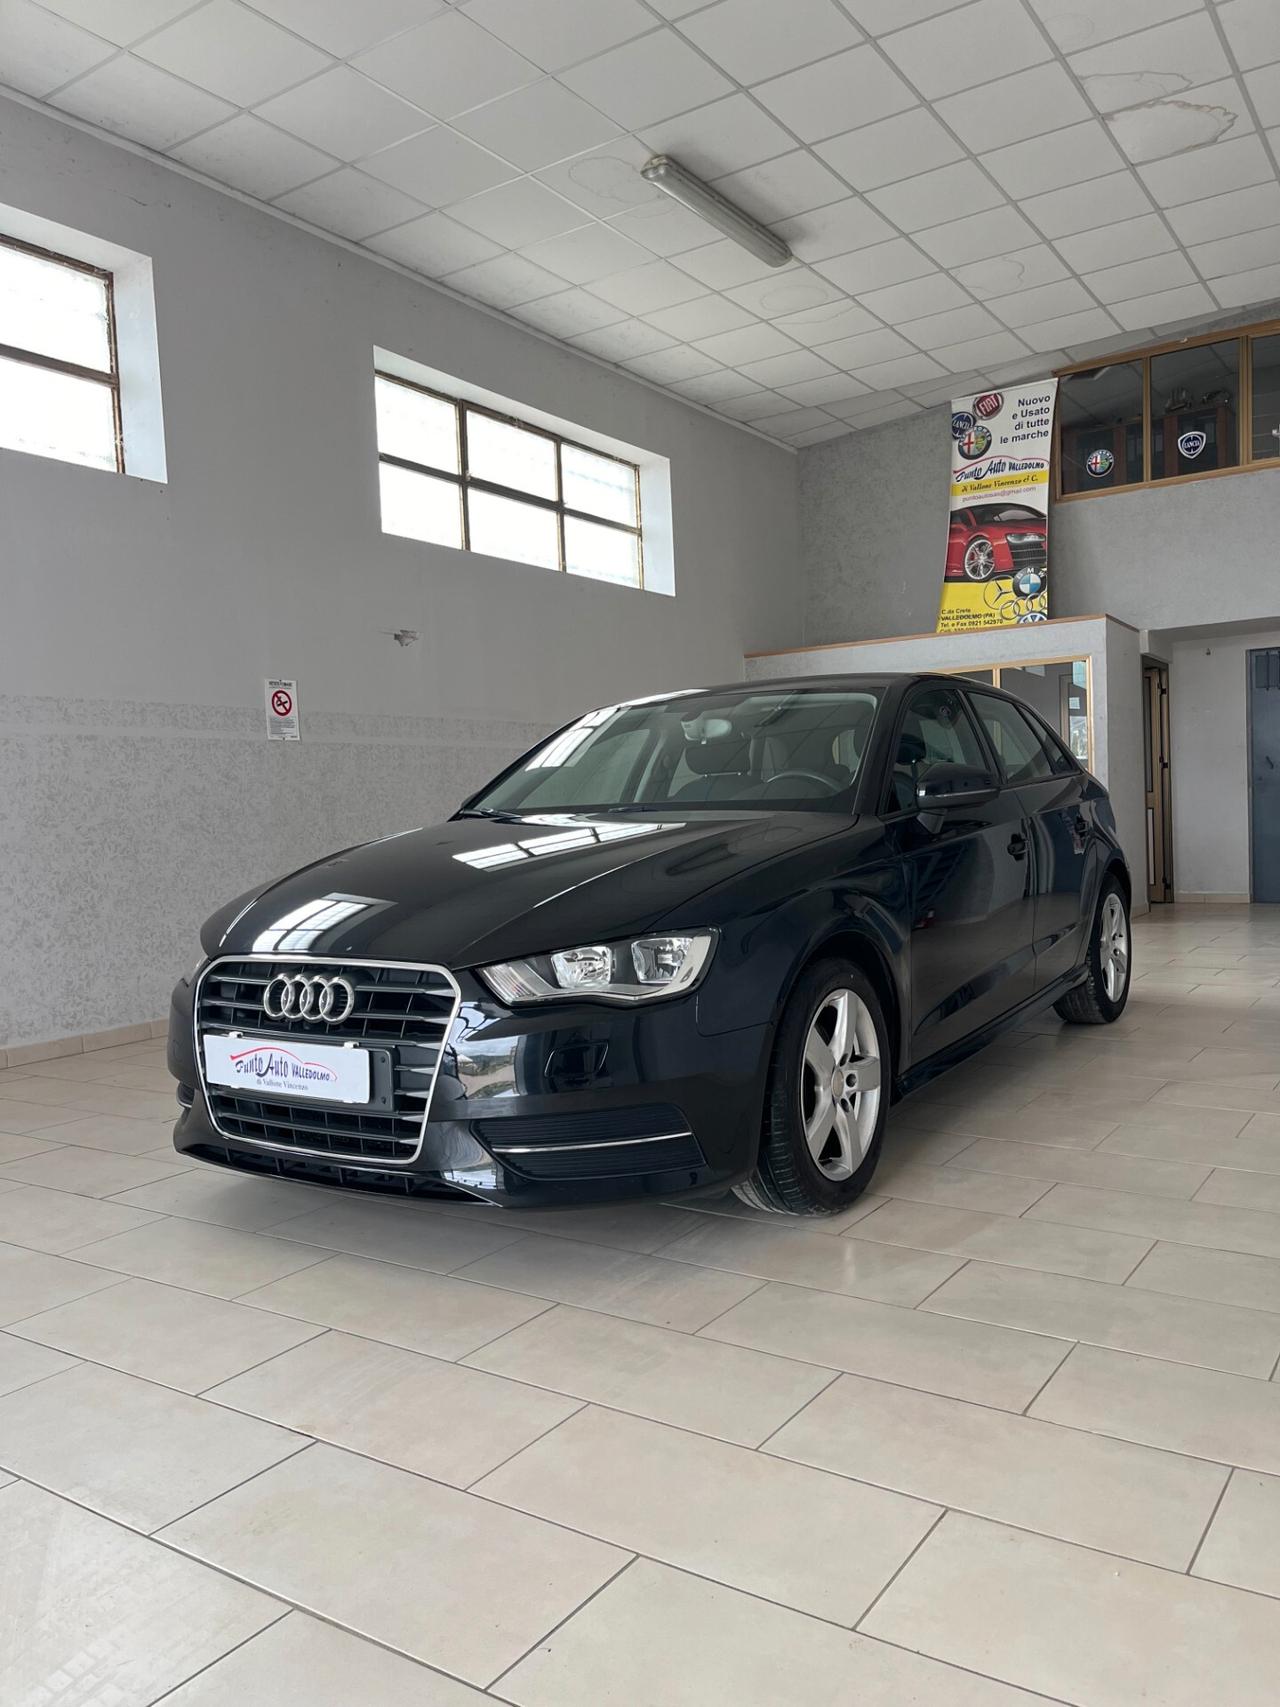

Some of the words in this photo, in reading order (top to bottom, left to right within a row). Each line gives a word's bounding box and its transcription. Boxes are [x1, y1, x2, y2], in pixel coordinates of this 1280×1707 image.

[979, 395, 999, 415] FIAT
[1017, 395, 1051, 407] Nuovo
[1021, 407, 1050, 418] Usato
[1015, 422, 1024, 431] di
[1027, 418, 1050, 428] tutte
[1000, 435, 1009, 445] le
[1012, 430, 1049, 442] marche
[956, 467, 982, 482] Punto
[974, 459, 1007, 480] Auto
[1008, 461, 1045, 472] VALLEDOLMO
[235, 1053, 263, 1074] Punto
[256, 1053, 289, 1077] Auto
[291, 1064, 331, 1082] VALLEDOLMO
